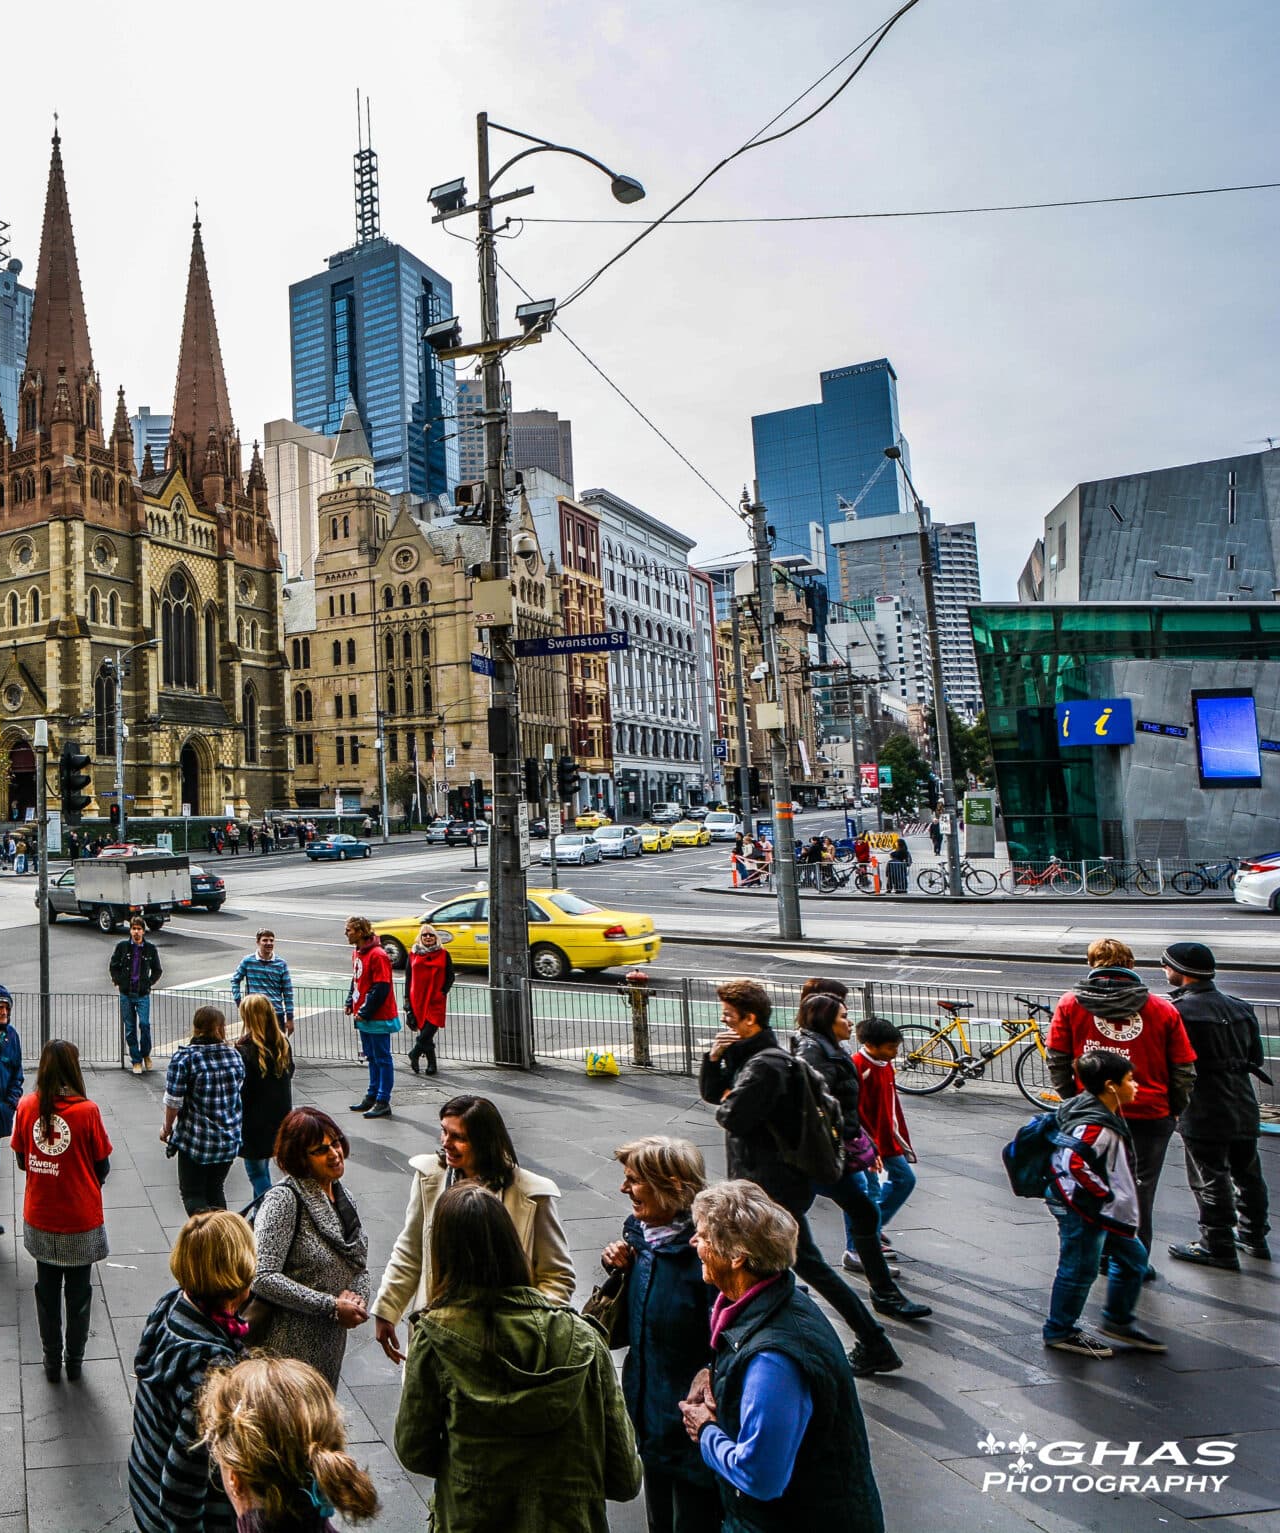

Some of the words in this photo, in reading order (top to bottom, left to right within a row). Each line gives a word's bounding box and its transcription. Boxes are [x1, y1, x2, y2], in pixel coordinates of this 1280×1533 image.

[547, 636, 608, 649] Swanston
[610, 633, 625, 644] St
[1142, 722, 1160, 733] THE
[716, 747, 724, 756] P
[1097, 1022, 1111, 1036] RED
[1114, 1025, 1141, 1040] CROSS
